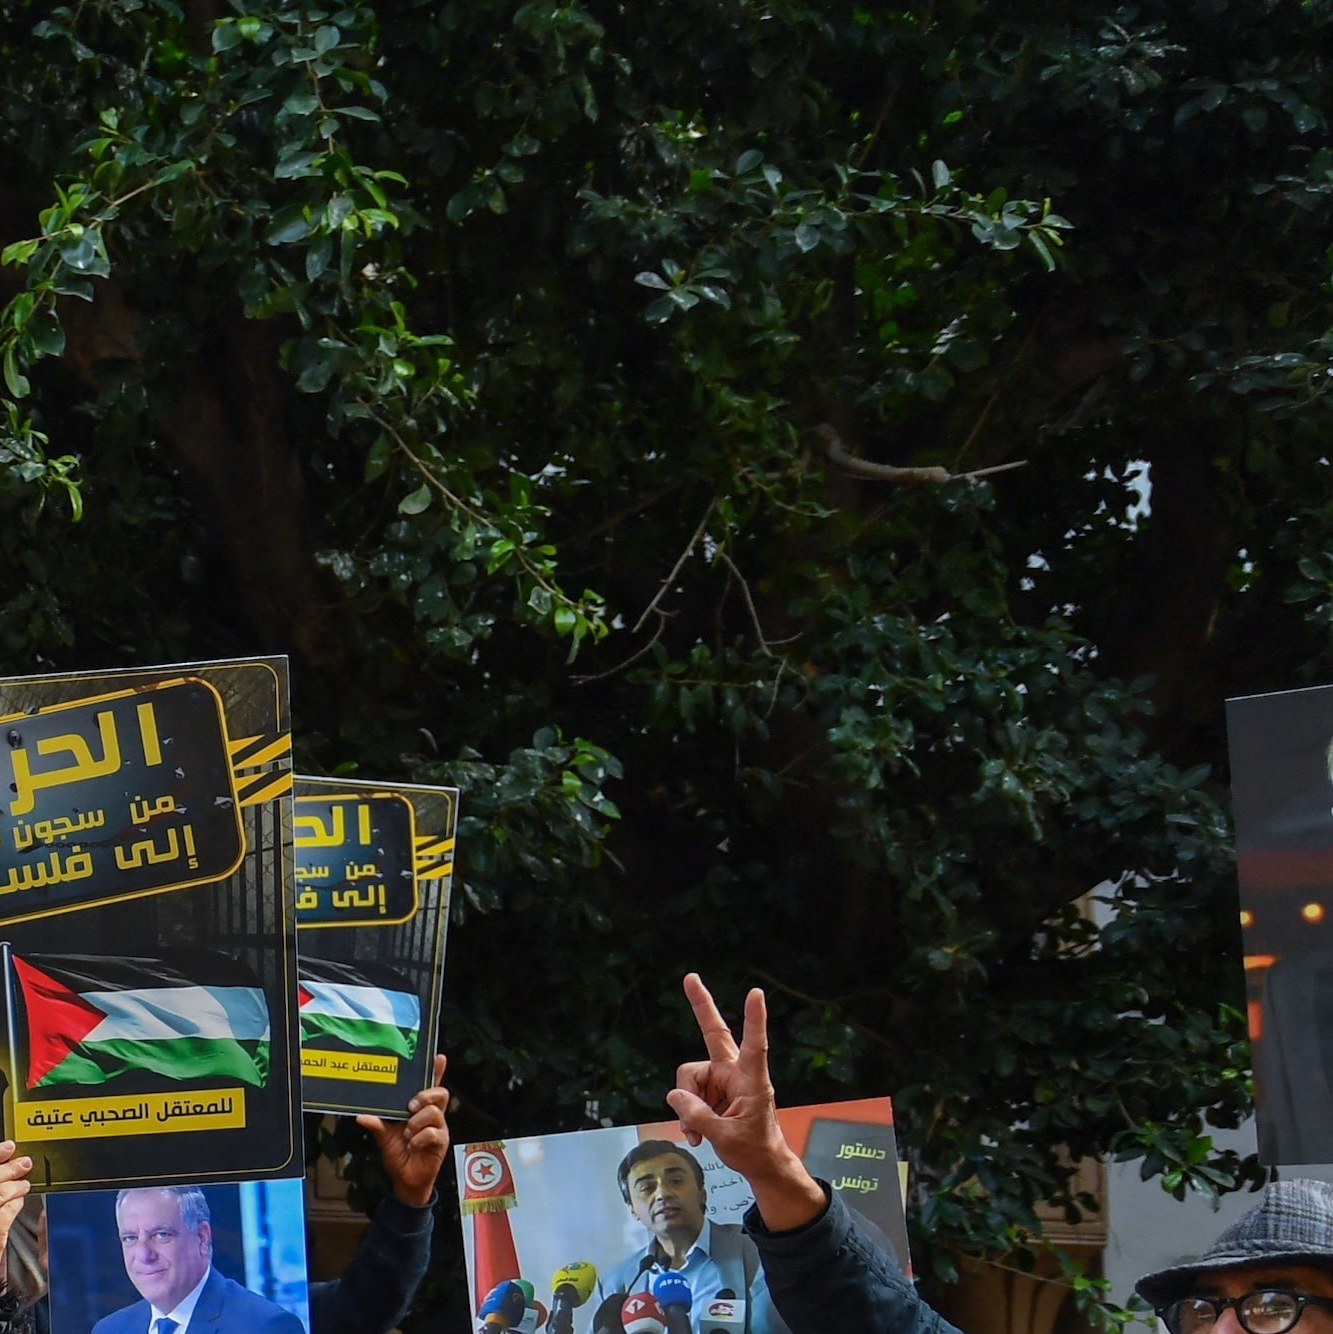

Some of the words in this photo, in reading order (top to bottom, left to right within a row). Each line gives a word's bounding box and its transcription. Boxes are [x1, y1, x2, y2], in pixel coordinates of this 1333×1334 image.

[130, 793, 176, 824] من
[12, 809, 106, 850] سجون
[293, 803, 372, 849] الح
[114, 824, 199, 871] إلى
[295, 864, 330, 882] سج
[345, 860, 376, 880] من
[332, 884, 387, 914] إلى
[301, 1058, 327, 1068] الحم
[329, 1060, 350, 1072] عبد
[352, 1061, 397, 1074] للمعتقل
[26, 1109, 73, 1130] عتيق
[79, 1103, 150, 1127] الصحبي
[156, 1097, 232, 1122] للمعتقل
[835, 1143, 886, 1160] دستور
[832, 1174, 879, 1193] تونس
